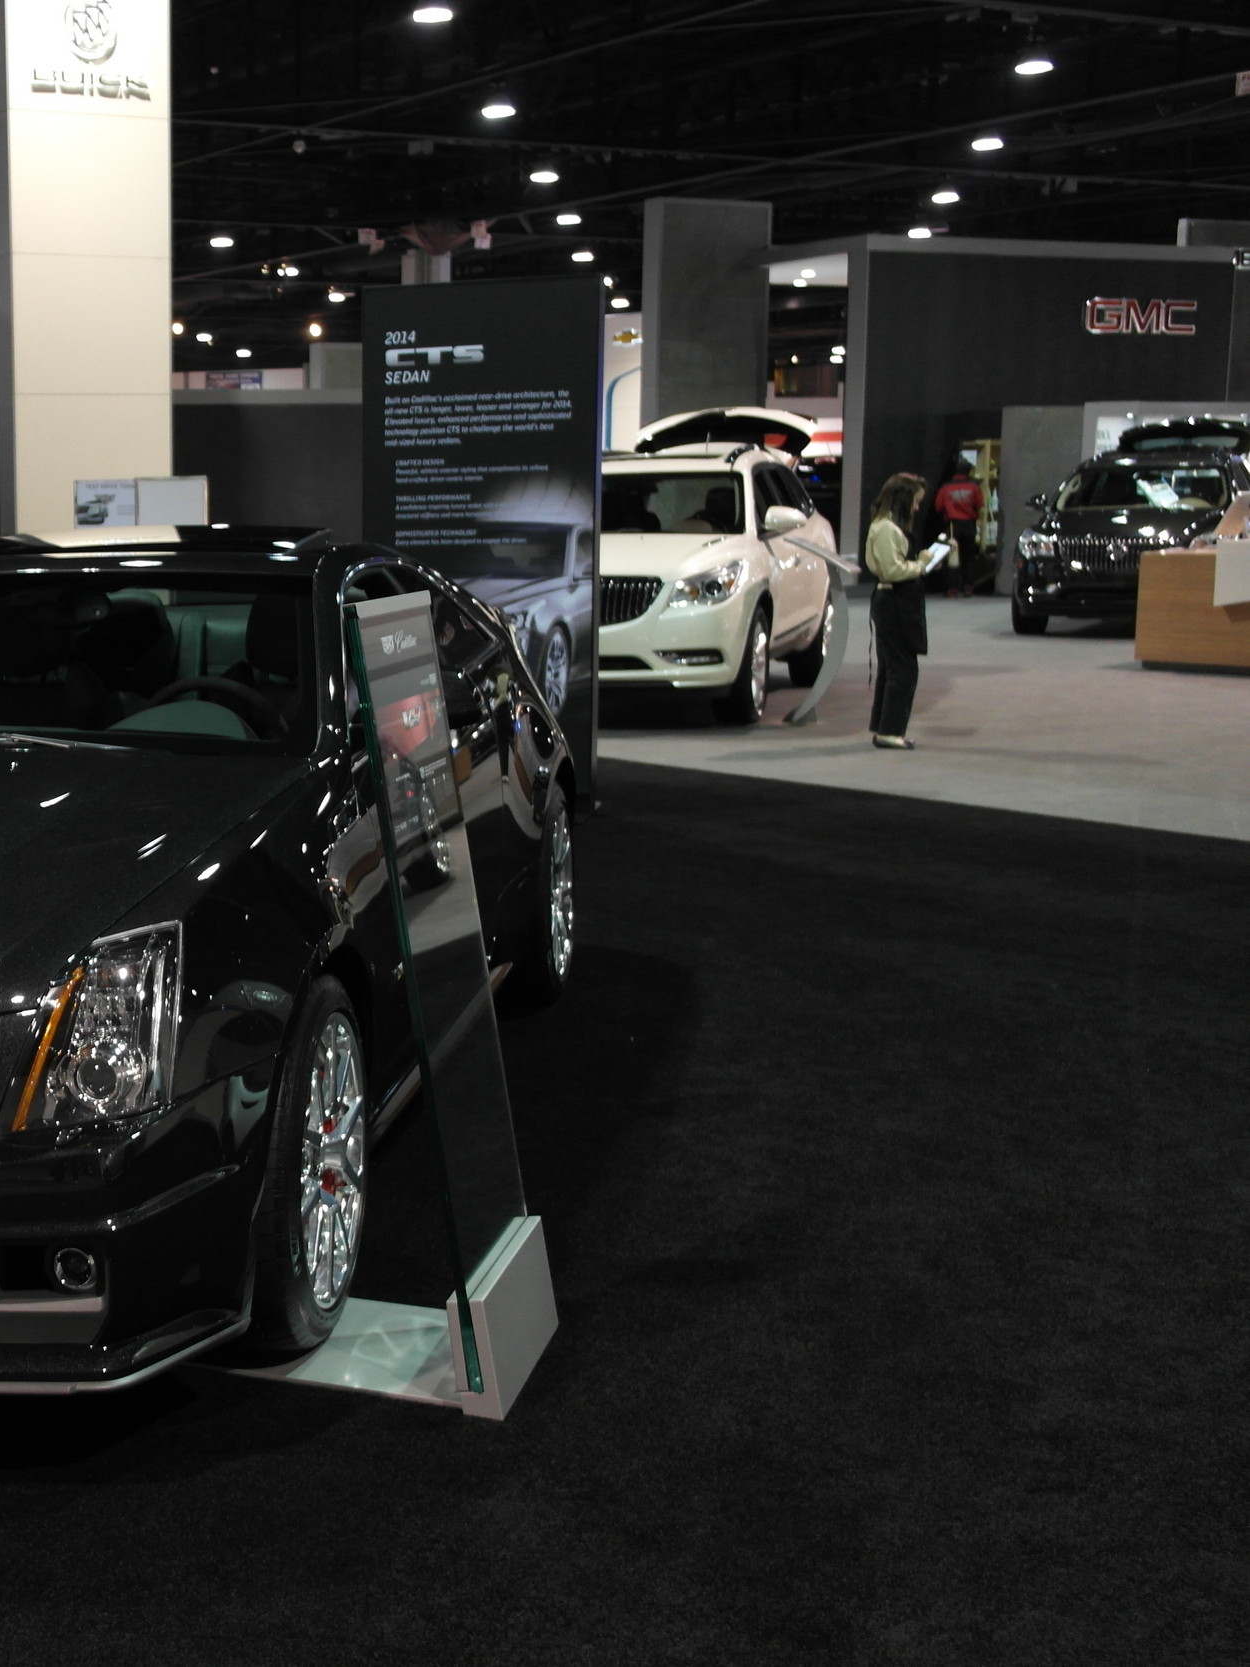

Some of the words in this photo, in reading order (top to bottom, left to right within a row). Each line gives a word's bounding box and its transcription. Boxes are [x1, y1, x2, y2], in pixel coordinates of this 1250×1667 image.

[31, 69, 151, 101] BUICK
[1085, 296, 1197, 335] GMC
[384, 330, 416, 345] 2014
[385, 344, 485, 367] CTS
[384, 370, 430, 385] SEDAN
[409, 404, 423, 414] CTS
[446, 424, 461, 434] CTS
